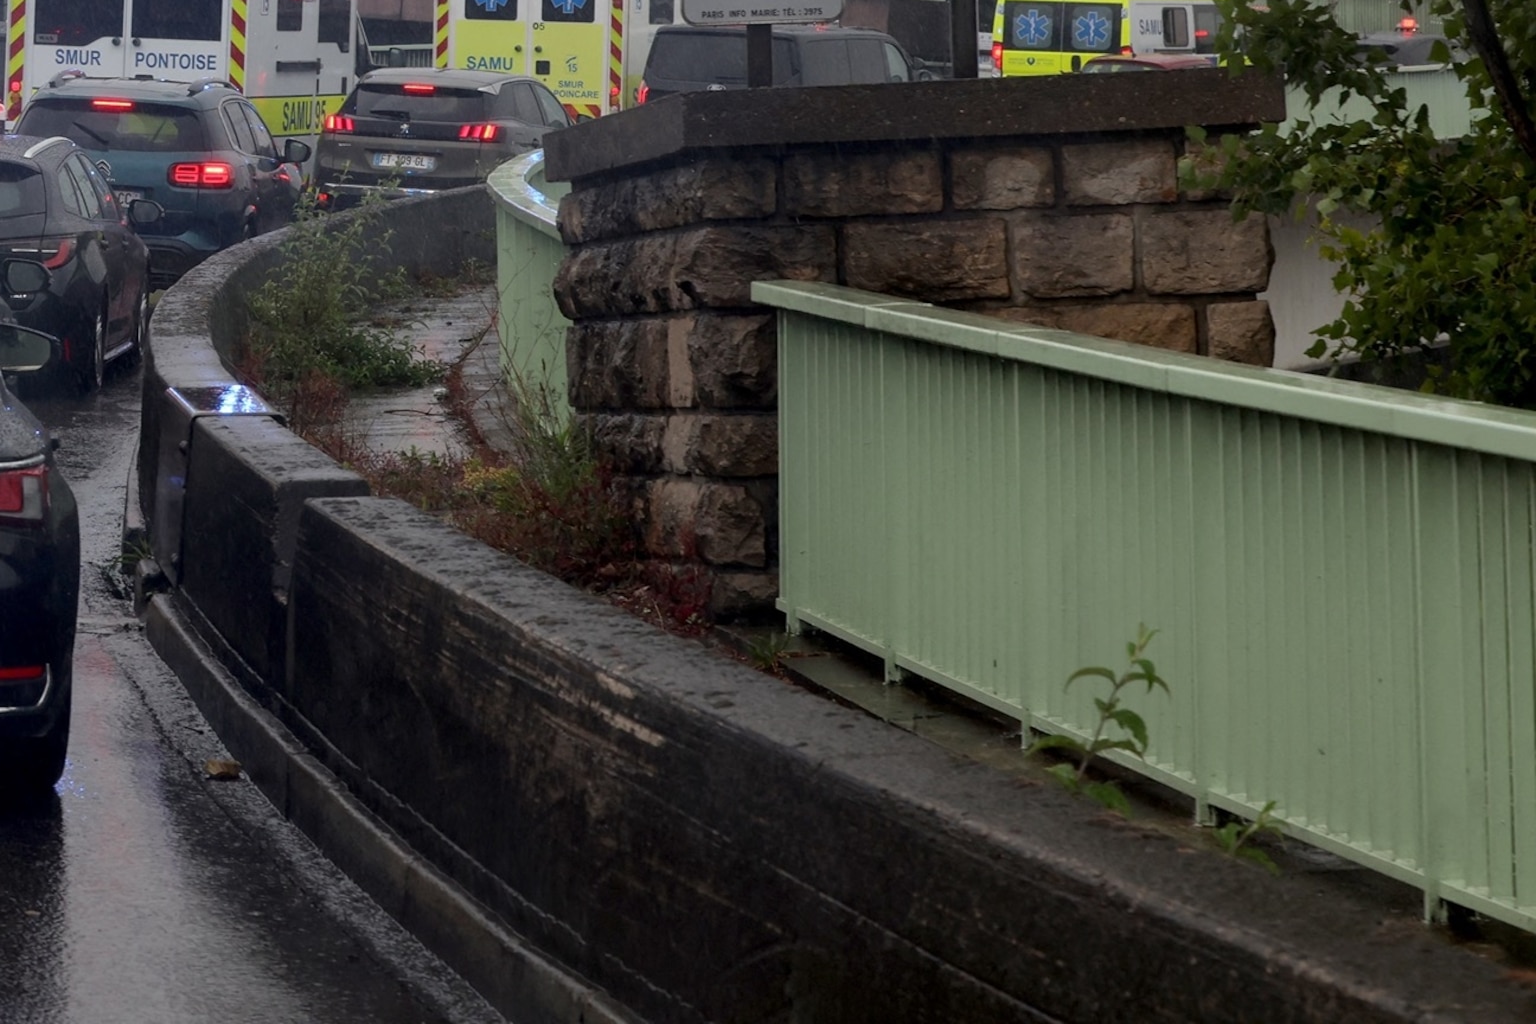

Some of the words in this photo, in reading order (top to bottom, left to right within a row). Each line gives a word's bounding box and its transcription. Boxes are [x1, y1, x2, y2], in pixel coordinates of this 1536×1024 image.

[702, 10, 724, 19] PARIS
[729, 9, 746, 18] INFO
[55, 49, 101, 66] SMUR
[135, 52, 217, 70] PONTOISE
[466, 56, 513, 71] SAMU
[567, 64, 578, 73] 15
[558, 80, 584, 89] SMUR
[282, 101, 313, 132] SAMU
